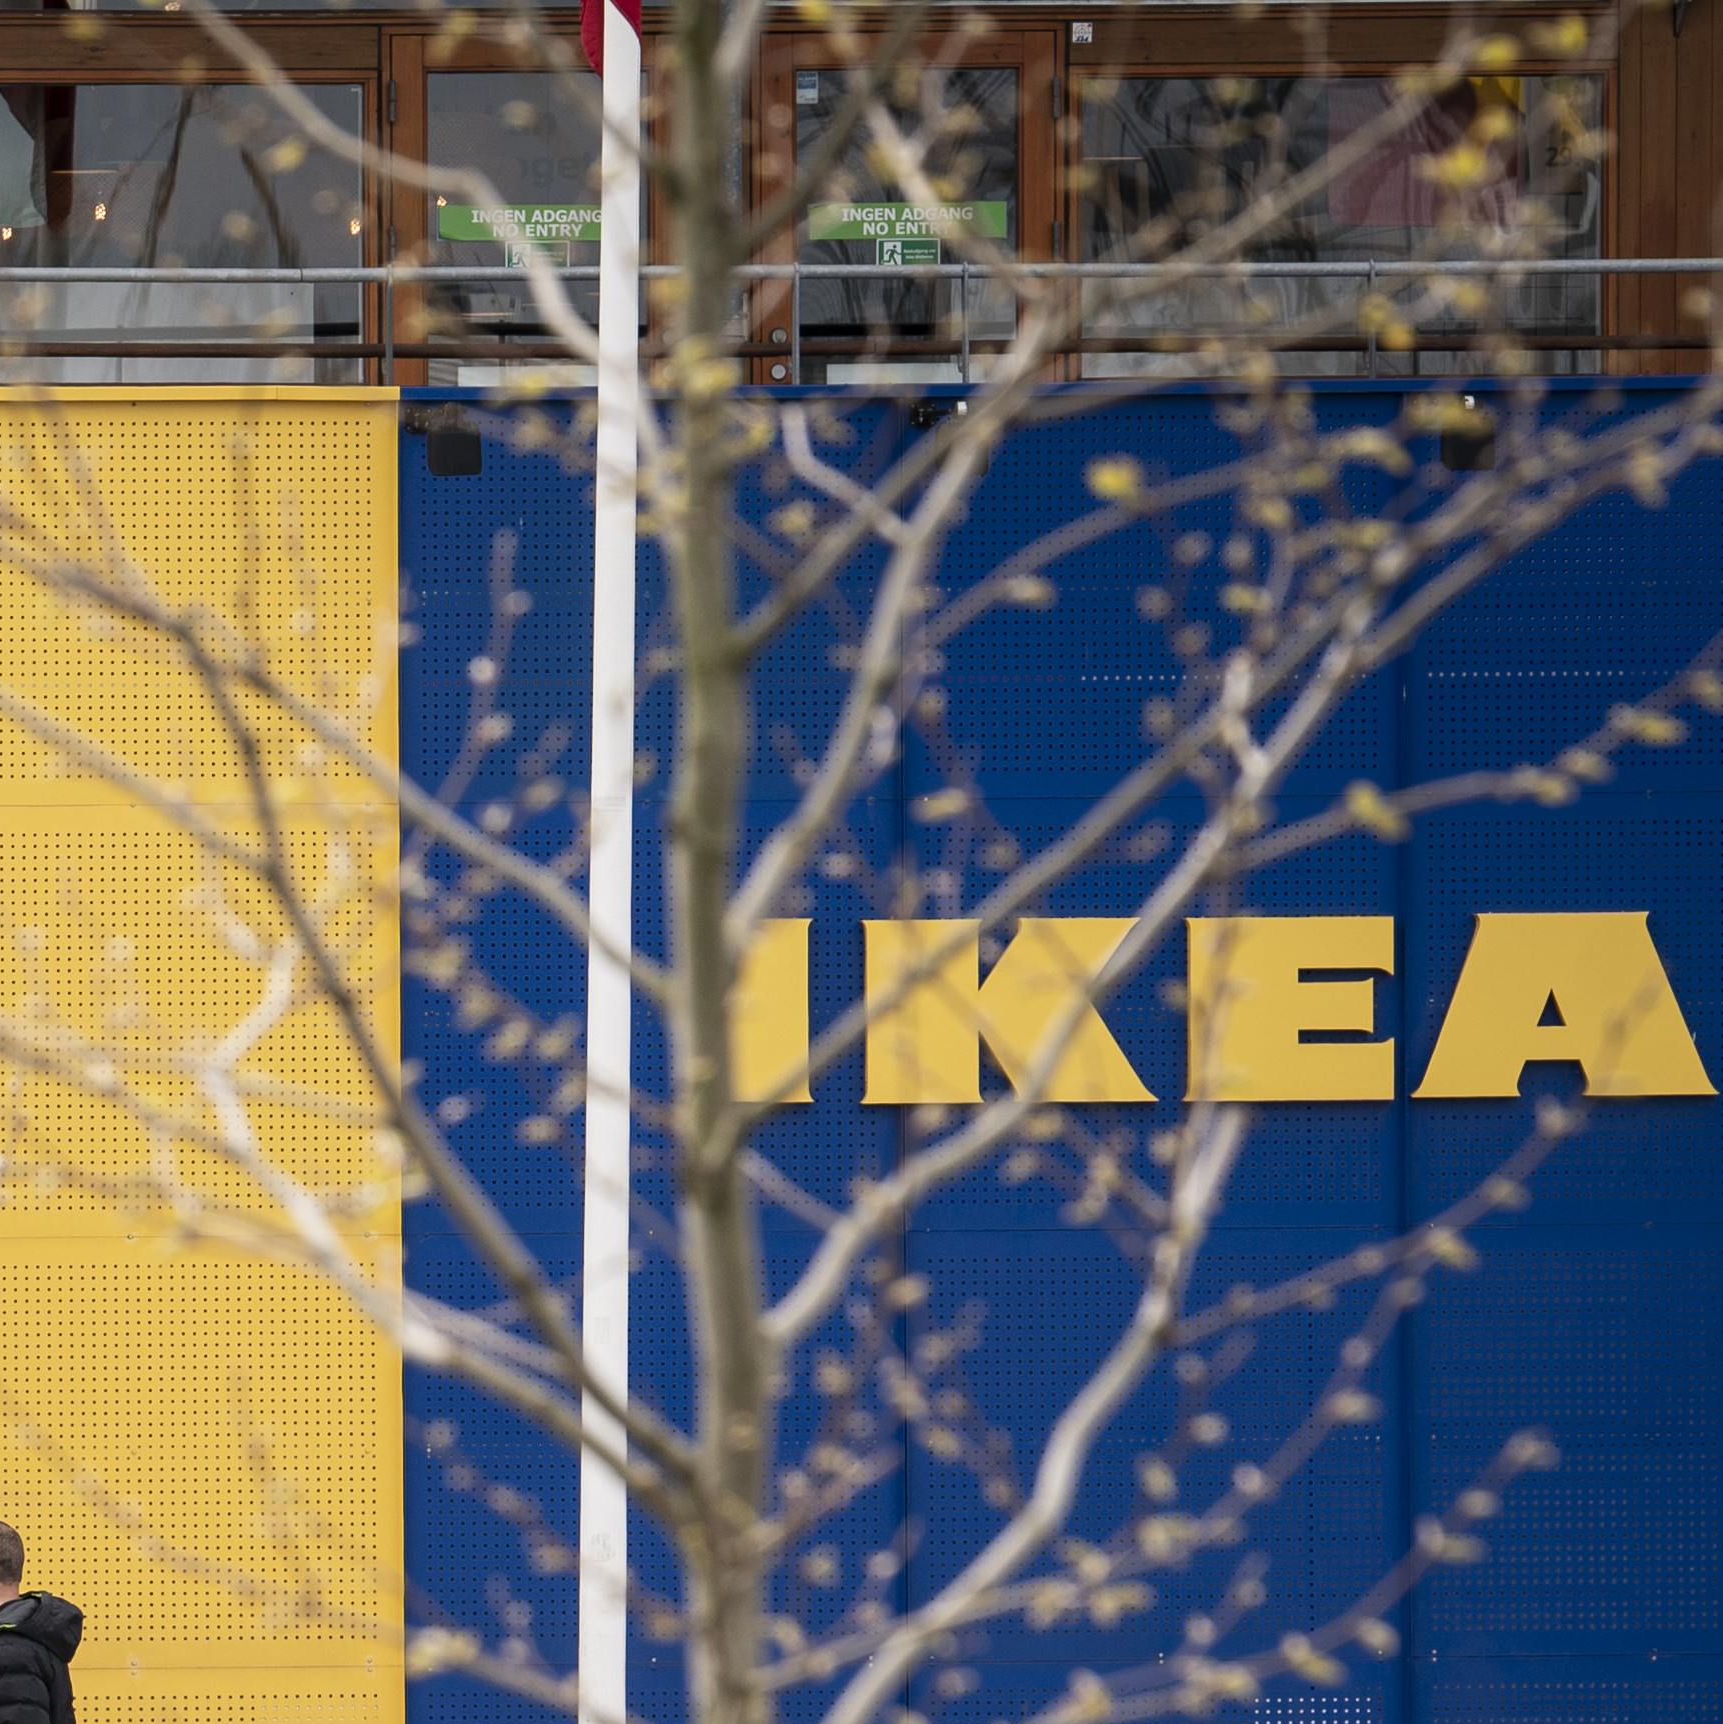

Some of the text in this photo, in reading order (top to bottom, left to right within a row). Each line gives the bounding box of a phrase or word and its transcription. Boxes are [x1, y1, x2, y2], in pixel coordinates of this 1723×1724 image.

[471, 209, 602, 223] INGEN ADGANG
[842, 206, 974, 221] INGEN ADGANG
[492, 223, 584, 237] NO ENTRY
[863, 222, 889, 236] NO
[731, 911, 1719, 1104] IKEA
